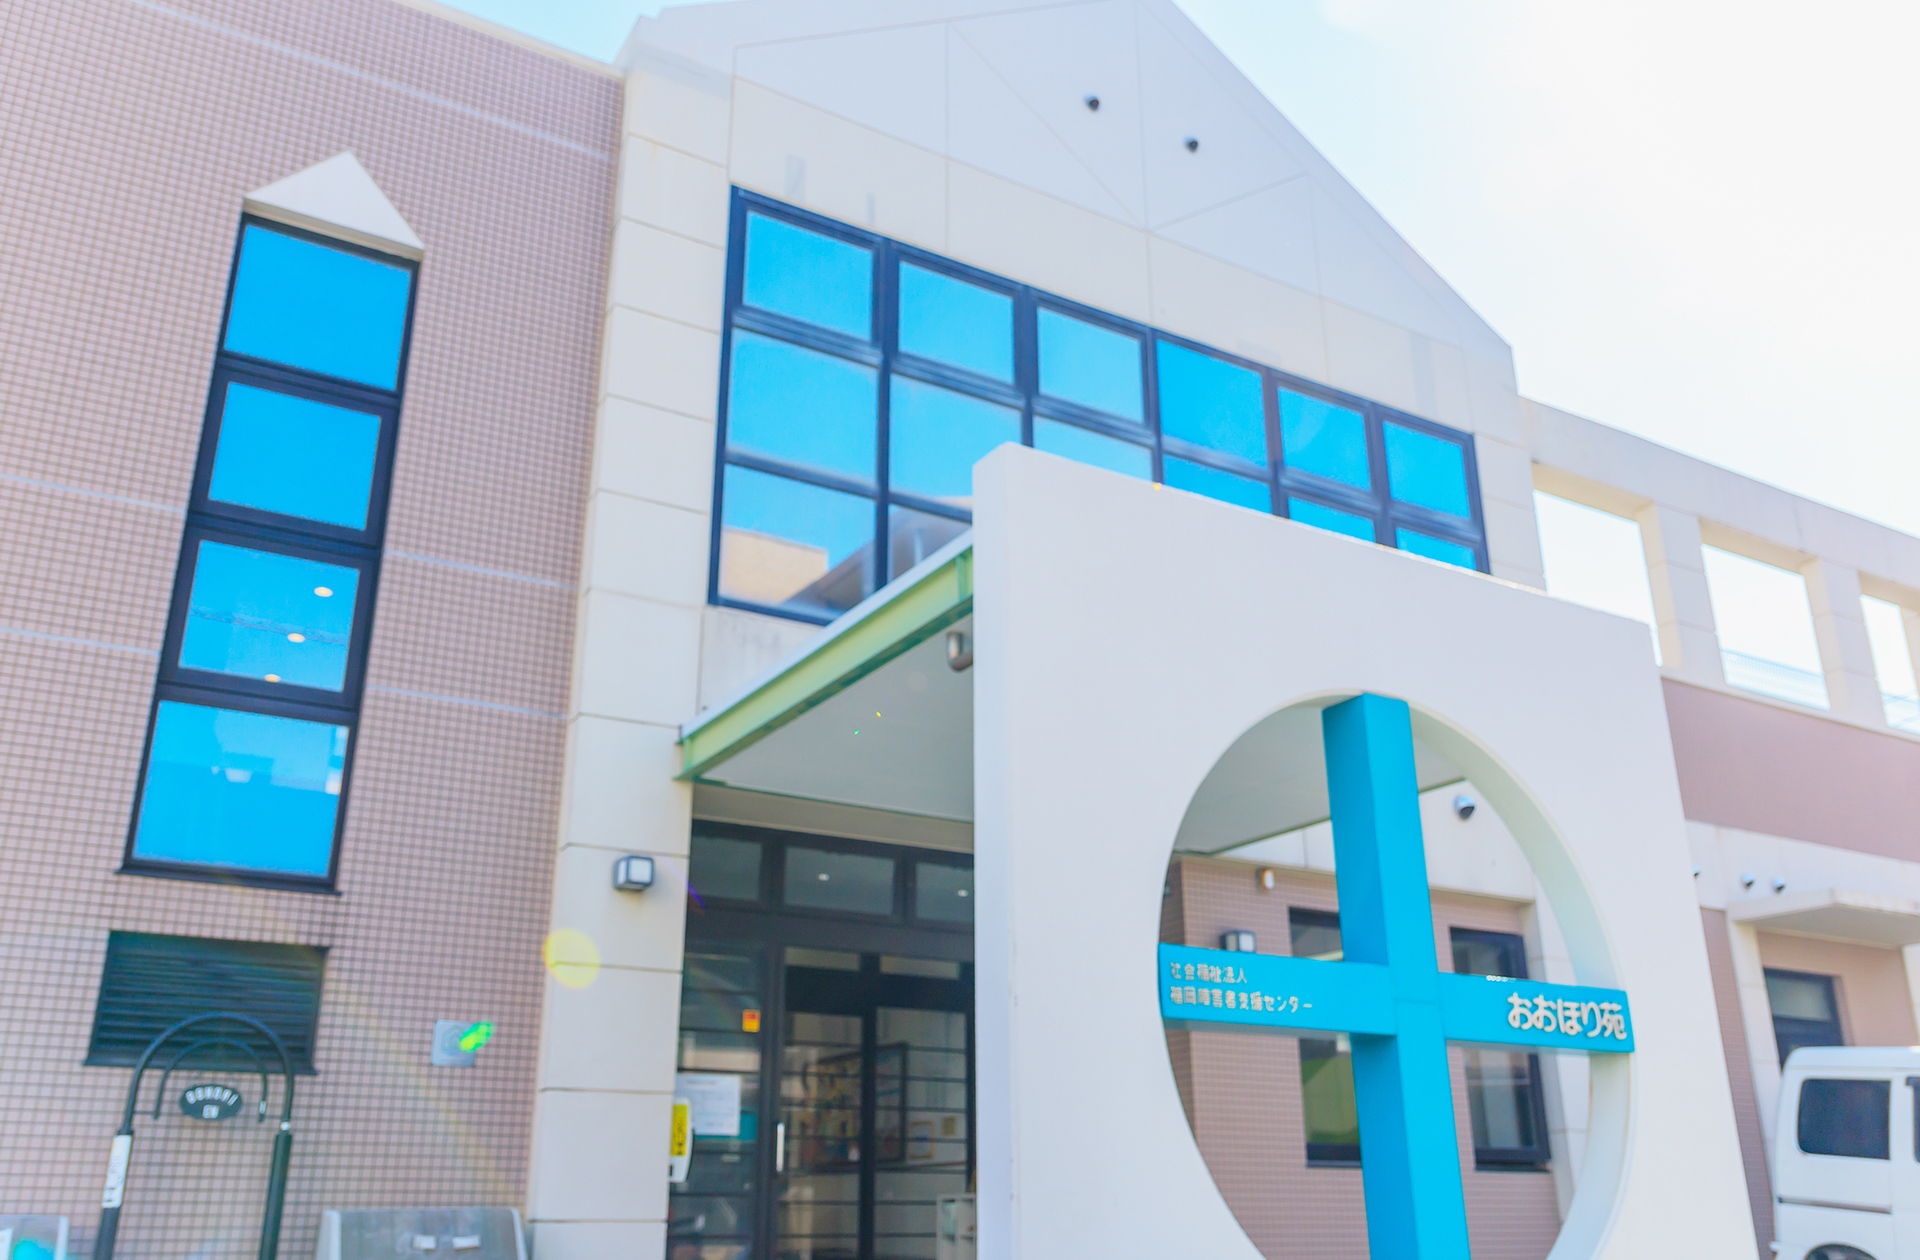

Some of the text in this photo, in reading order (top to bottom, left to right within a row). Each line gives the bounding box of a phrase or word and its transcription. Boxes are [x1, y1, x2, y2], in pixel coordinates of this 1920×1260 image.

[1170, 962, 1248, 984] 社会福祉法人
[1170, 985, 1313, 1013] 福岡障害者支援センター
[1507, 992, 1627, 1040] おおほり苑
